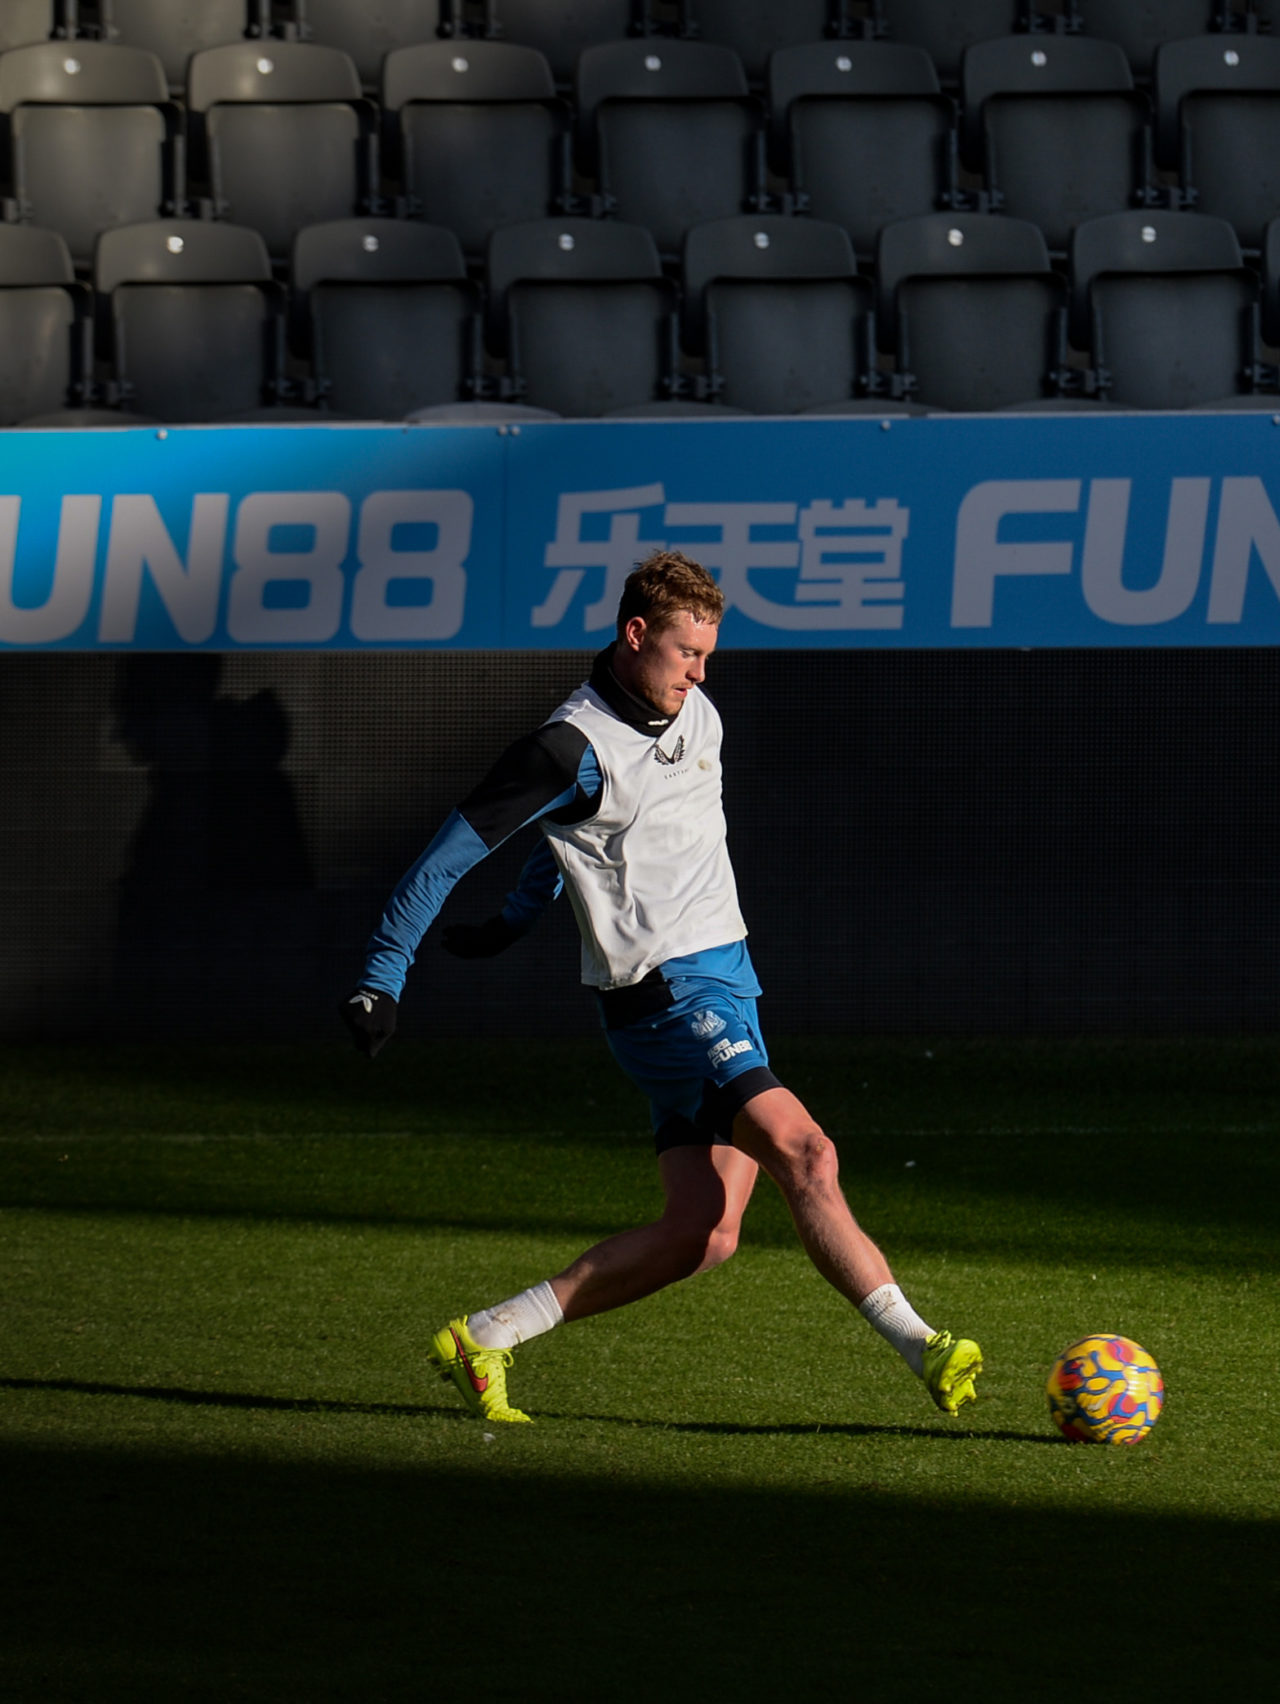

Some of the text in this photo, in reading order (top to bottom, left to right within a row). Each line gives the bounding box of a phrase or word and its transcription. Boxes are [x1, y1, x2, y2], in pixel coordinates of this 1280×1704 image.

[0, 490, 474, 644] UN88
[532, 483, 910, 632] 乐天堂
